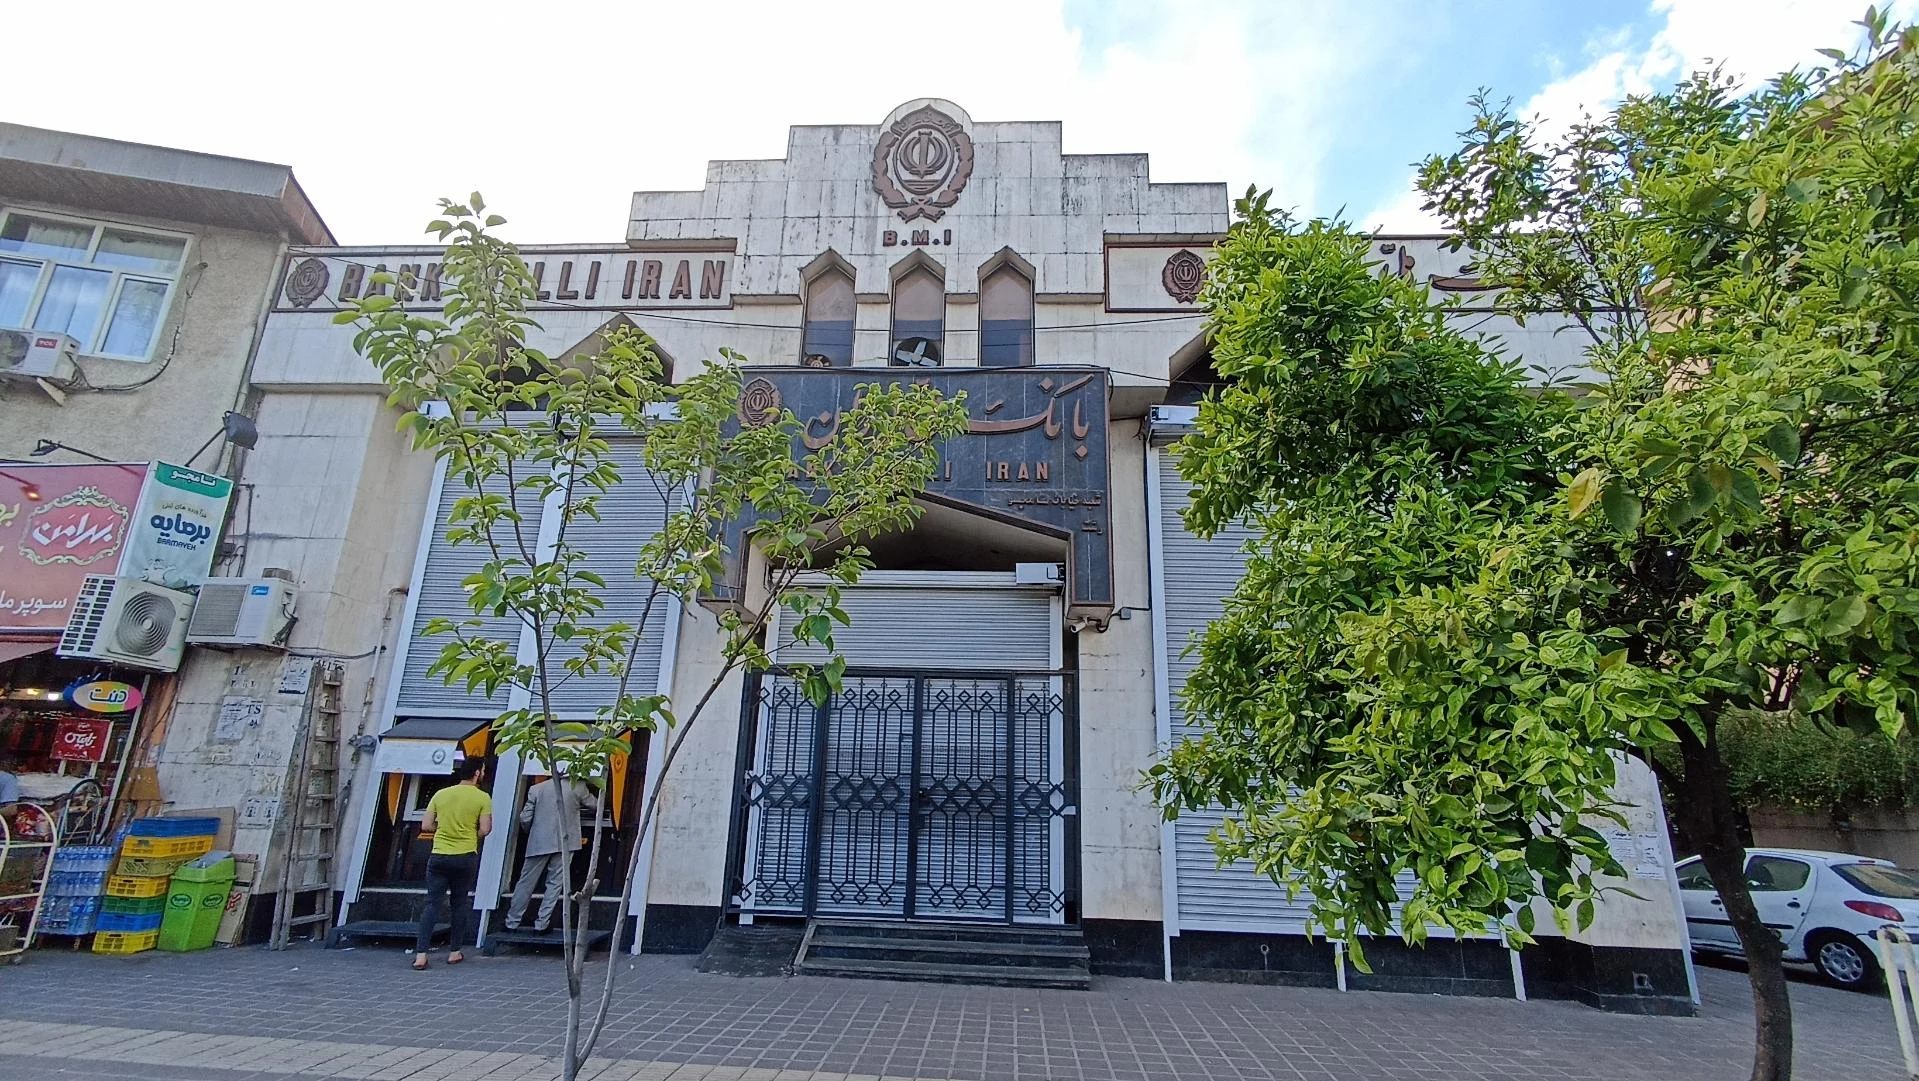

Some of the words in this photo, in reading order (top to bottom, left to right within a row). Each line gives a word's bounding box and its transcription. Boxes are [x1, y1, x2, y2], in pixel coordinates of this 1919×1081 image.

[883, 229, 952, 247] B.M.I
[622, 260, 726, 300] IRAN
[986, 461, 1049, 483] IRAN
[150, 512, 211, 545] برمایه
[12, 597, 68, 616] سوپر
